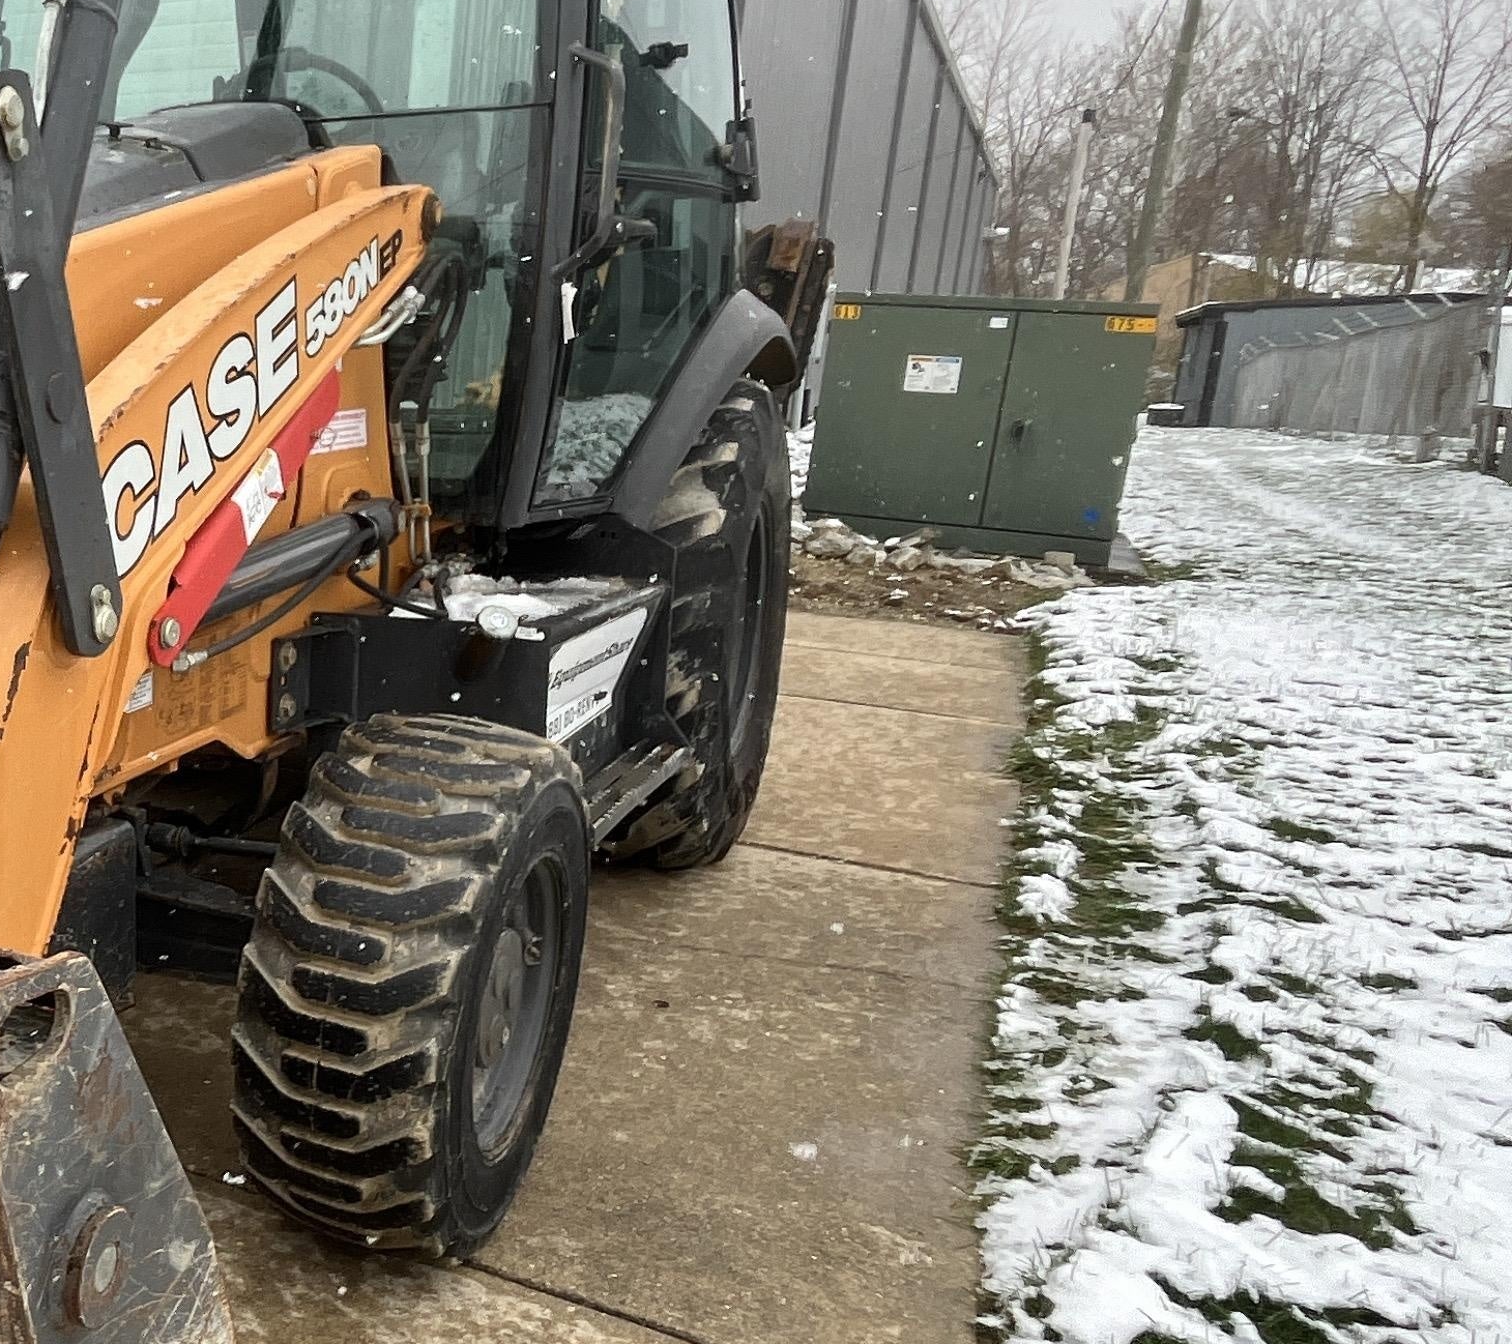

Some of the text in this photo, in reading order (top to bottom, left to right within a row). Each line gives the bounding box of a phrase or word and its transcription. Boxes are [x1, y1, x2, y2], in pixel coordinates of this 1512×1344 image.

[101, 273, 300, 577] CASE
[304, 233, 379, 358] 580N
[379, 227, 403, 282] EP
